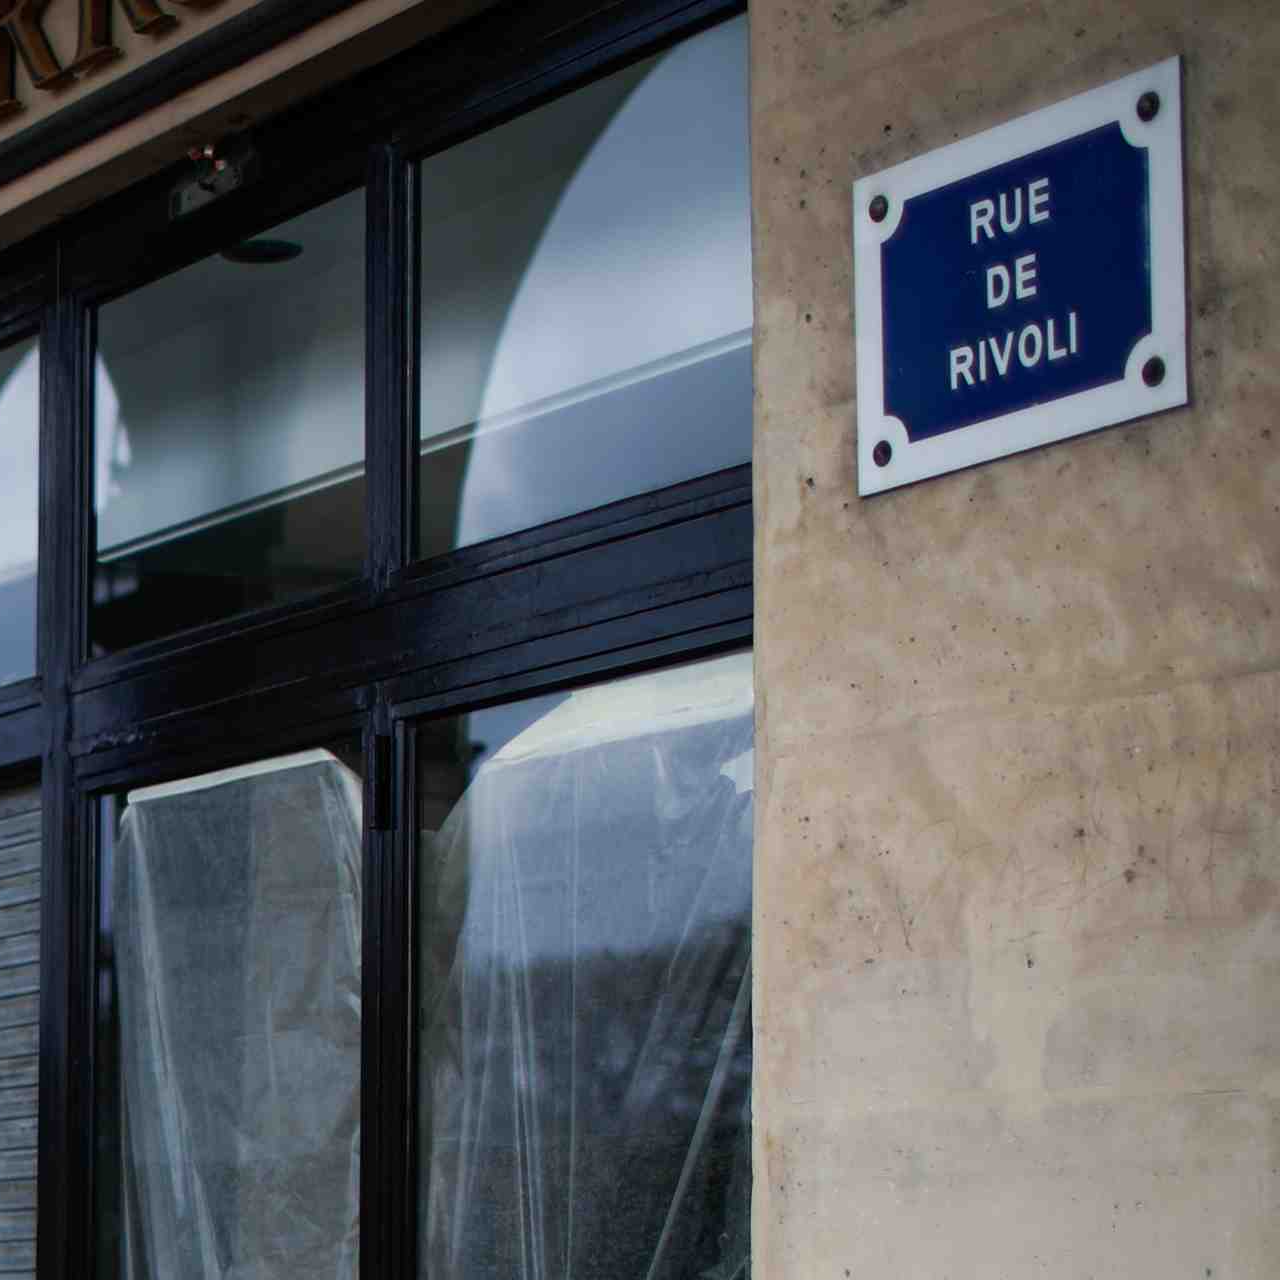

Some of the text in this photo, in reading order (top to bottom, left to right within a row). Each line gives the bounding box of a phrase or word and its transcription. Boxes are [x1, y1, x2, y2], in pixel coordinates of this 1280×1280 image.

[969, 177, 1050, 244] RUE
[985, 253, 1037, 309] DE
[948, 311, 1079, 390] RIVOLI
